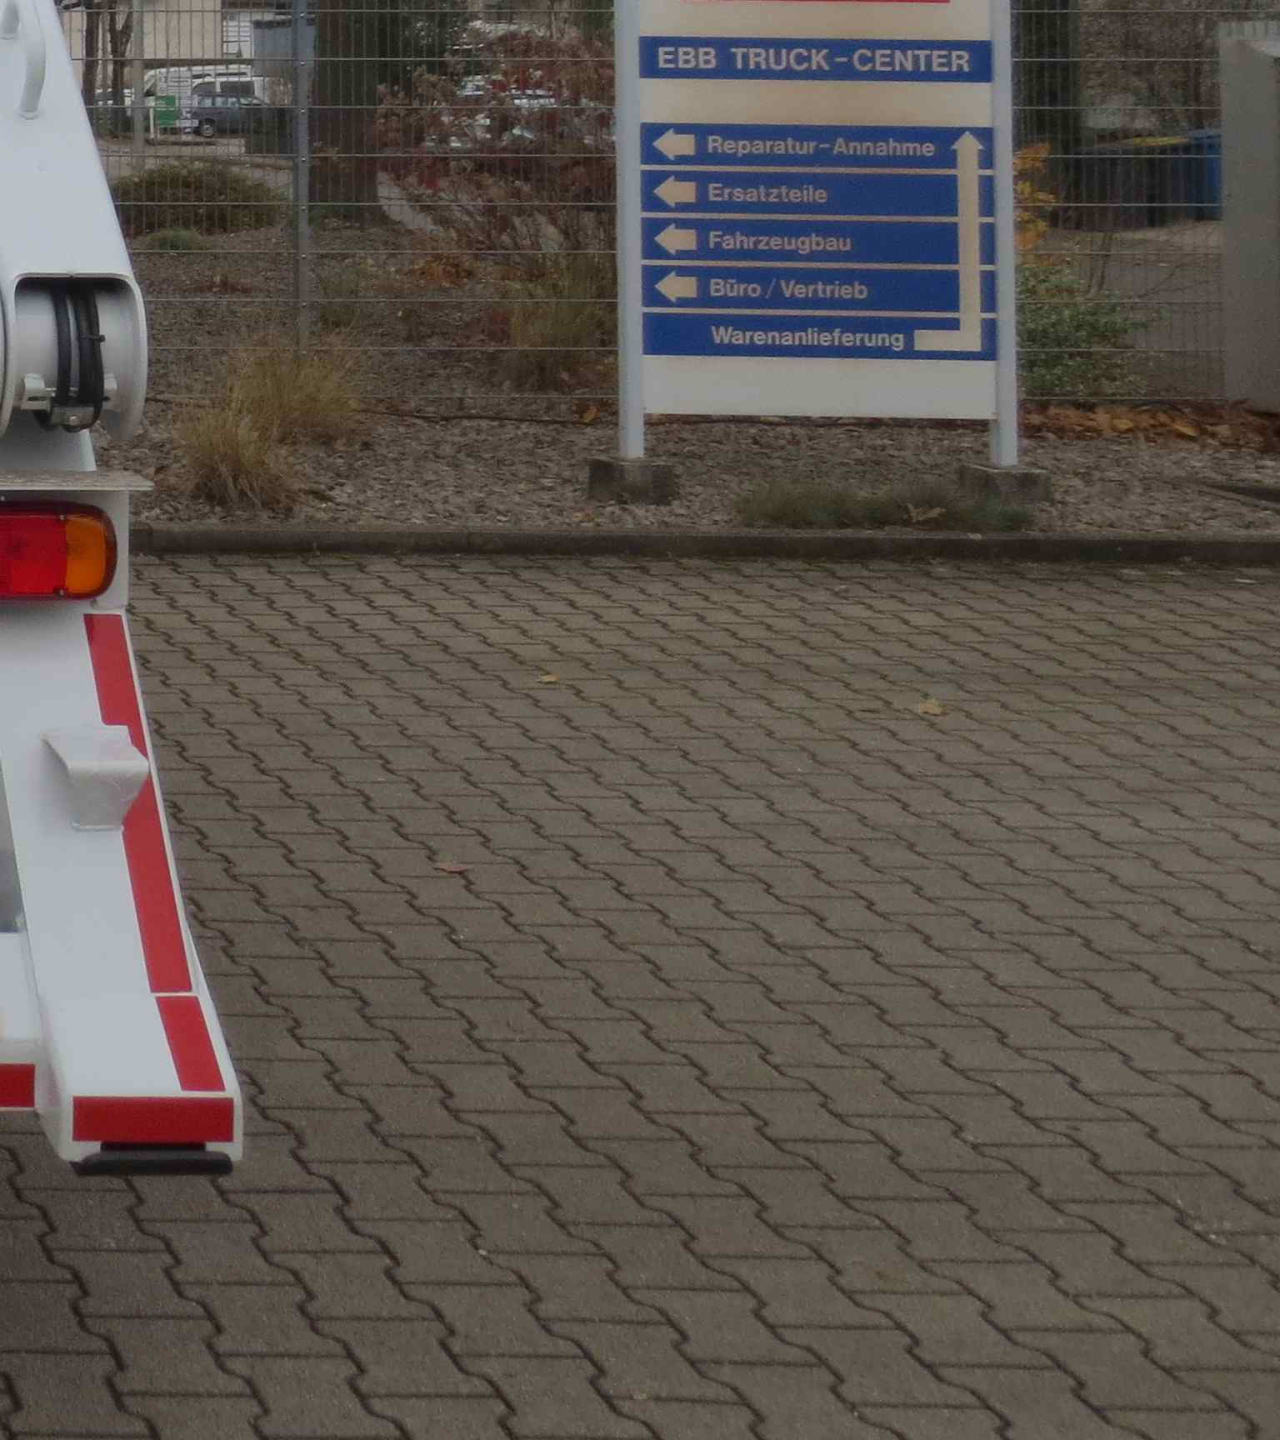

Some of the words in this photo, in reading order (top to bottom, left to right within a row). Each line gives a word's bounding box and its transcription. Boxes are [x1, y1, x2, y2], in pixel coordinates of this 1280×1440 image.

[658, 47, 716, 70] EBB
[707, 183, 828, 204] Ersatzteile
[708, 231, 852, 254] Fahrzeugbau
[709, 277, 762, 299] Büro
[780, 279, 868, 300] Vertrieb
[711, 325, 905, 351] Warenanlieferung
